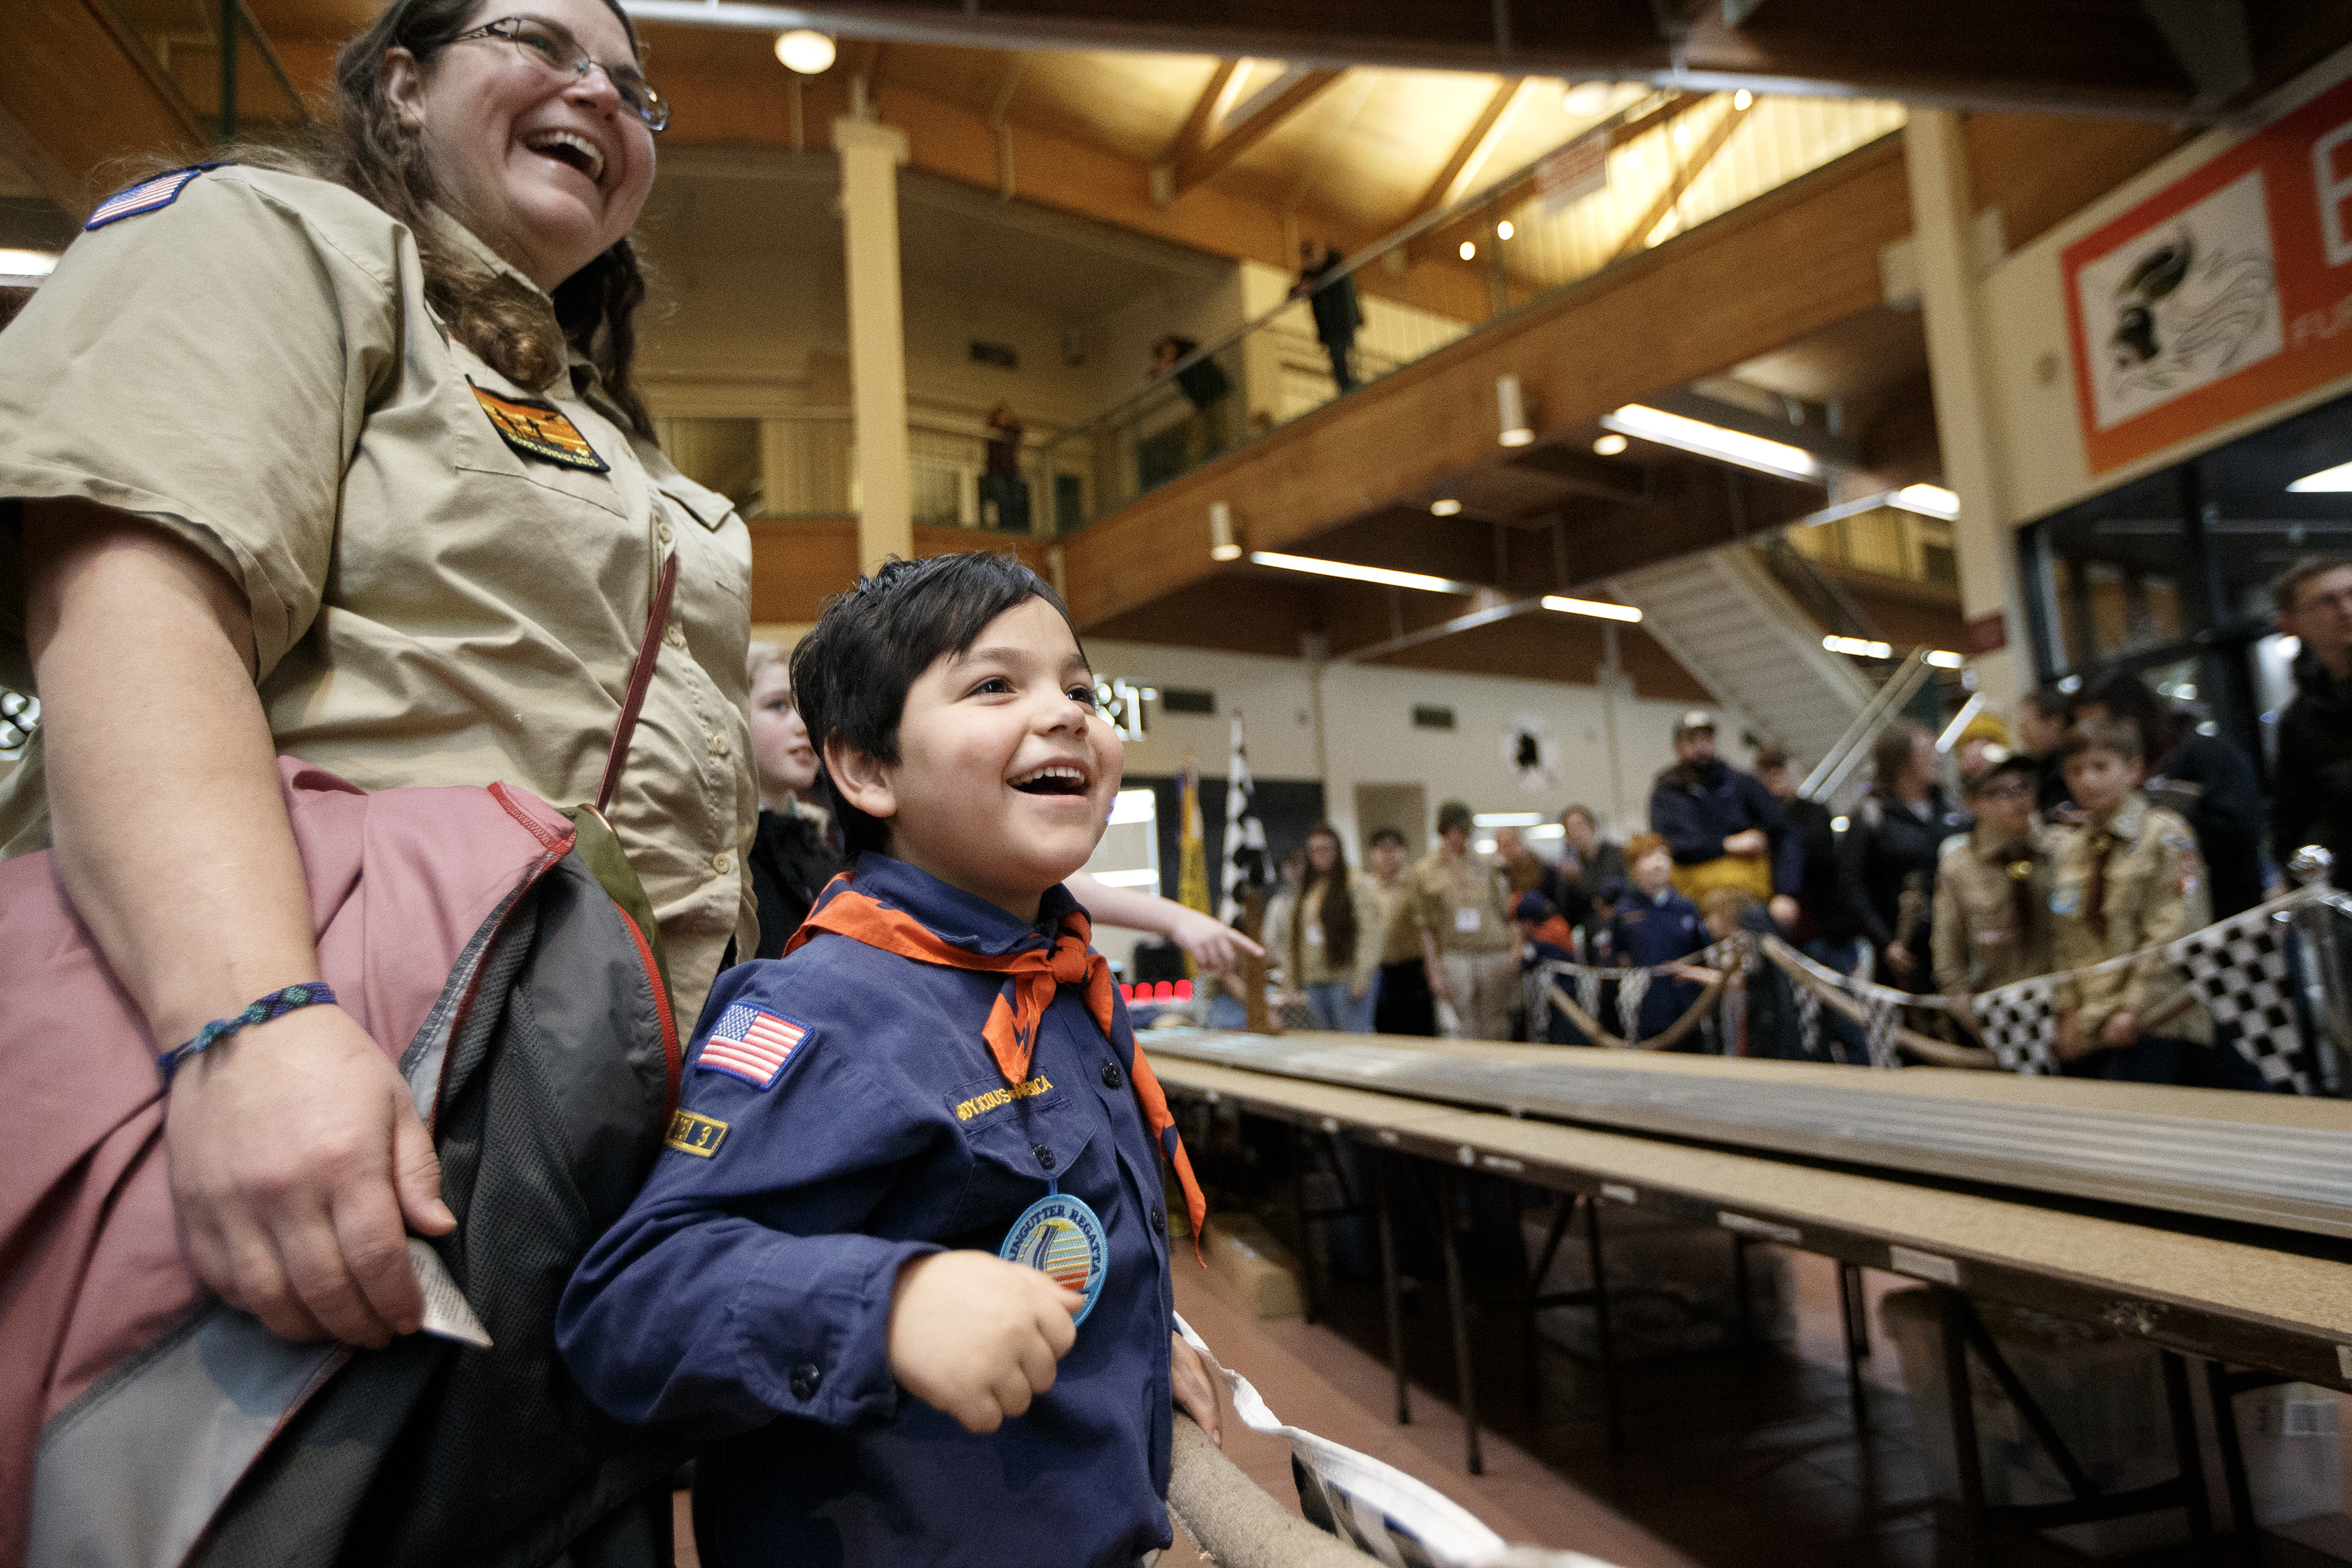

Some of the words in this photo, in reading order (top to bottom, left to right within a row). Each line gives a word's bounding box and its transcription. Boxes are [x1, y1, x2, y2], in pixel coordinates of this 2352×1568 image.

[694, 1126, 713, 1147] 3
[1008, 1205, 1066, 1261] INGUTTER
[1069, 1209, 1101, 1275] REGATTA
